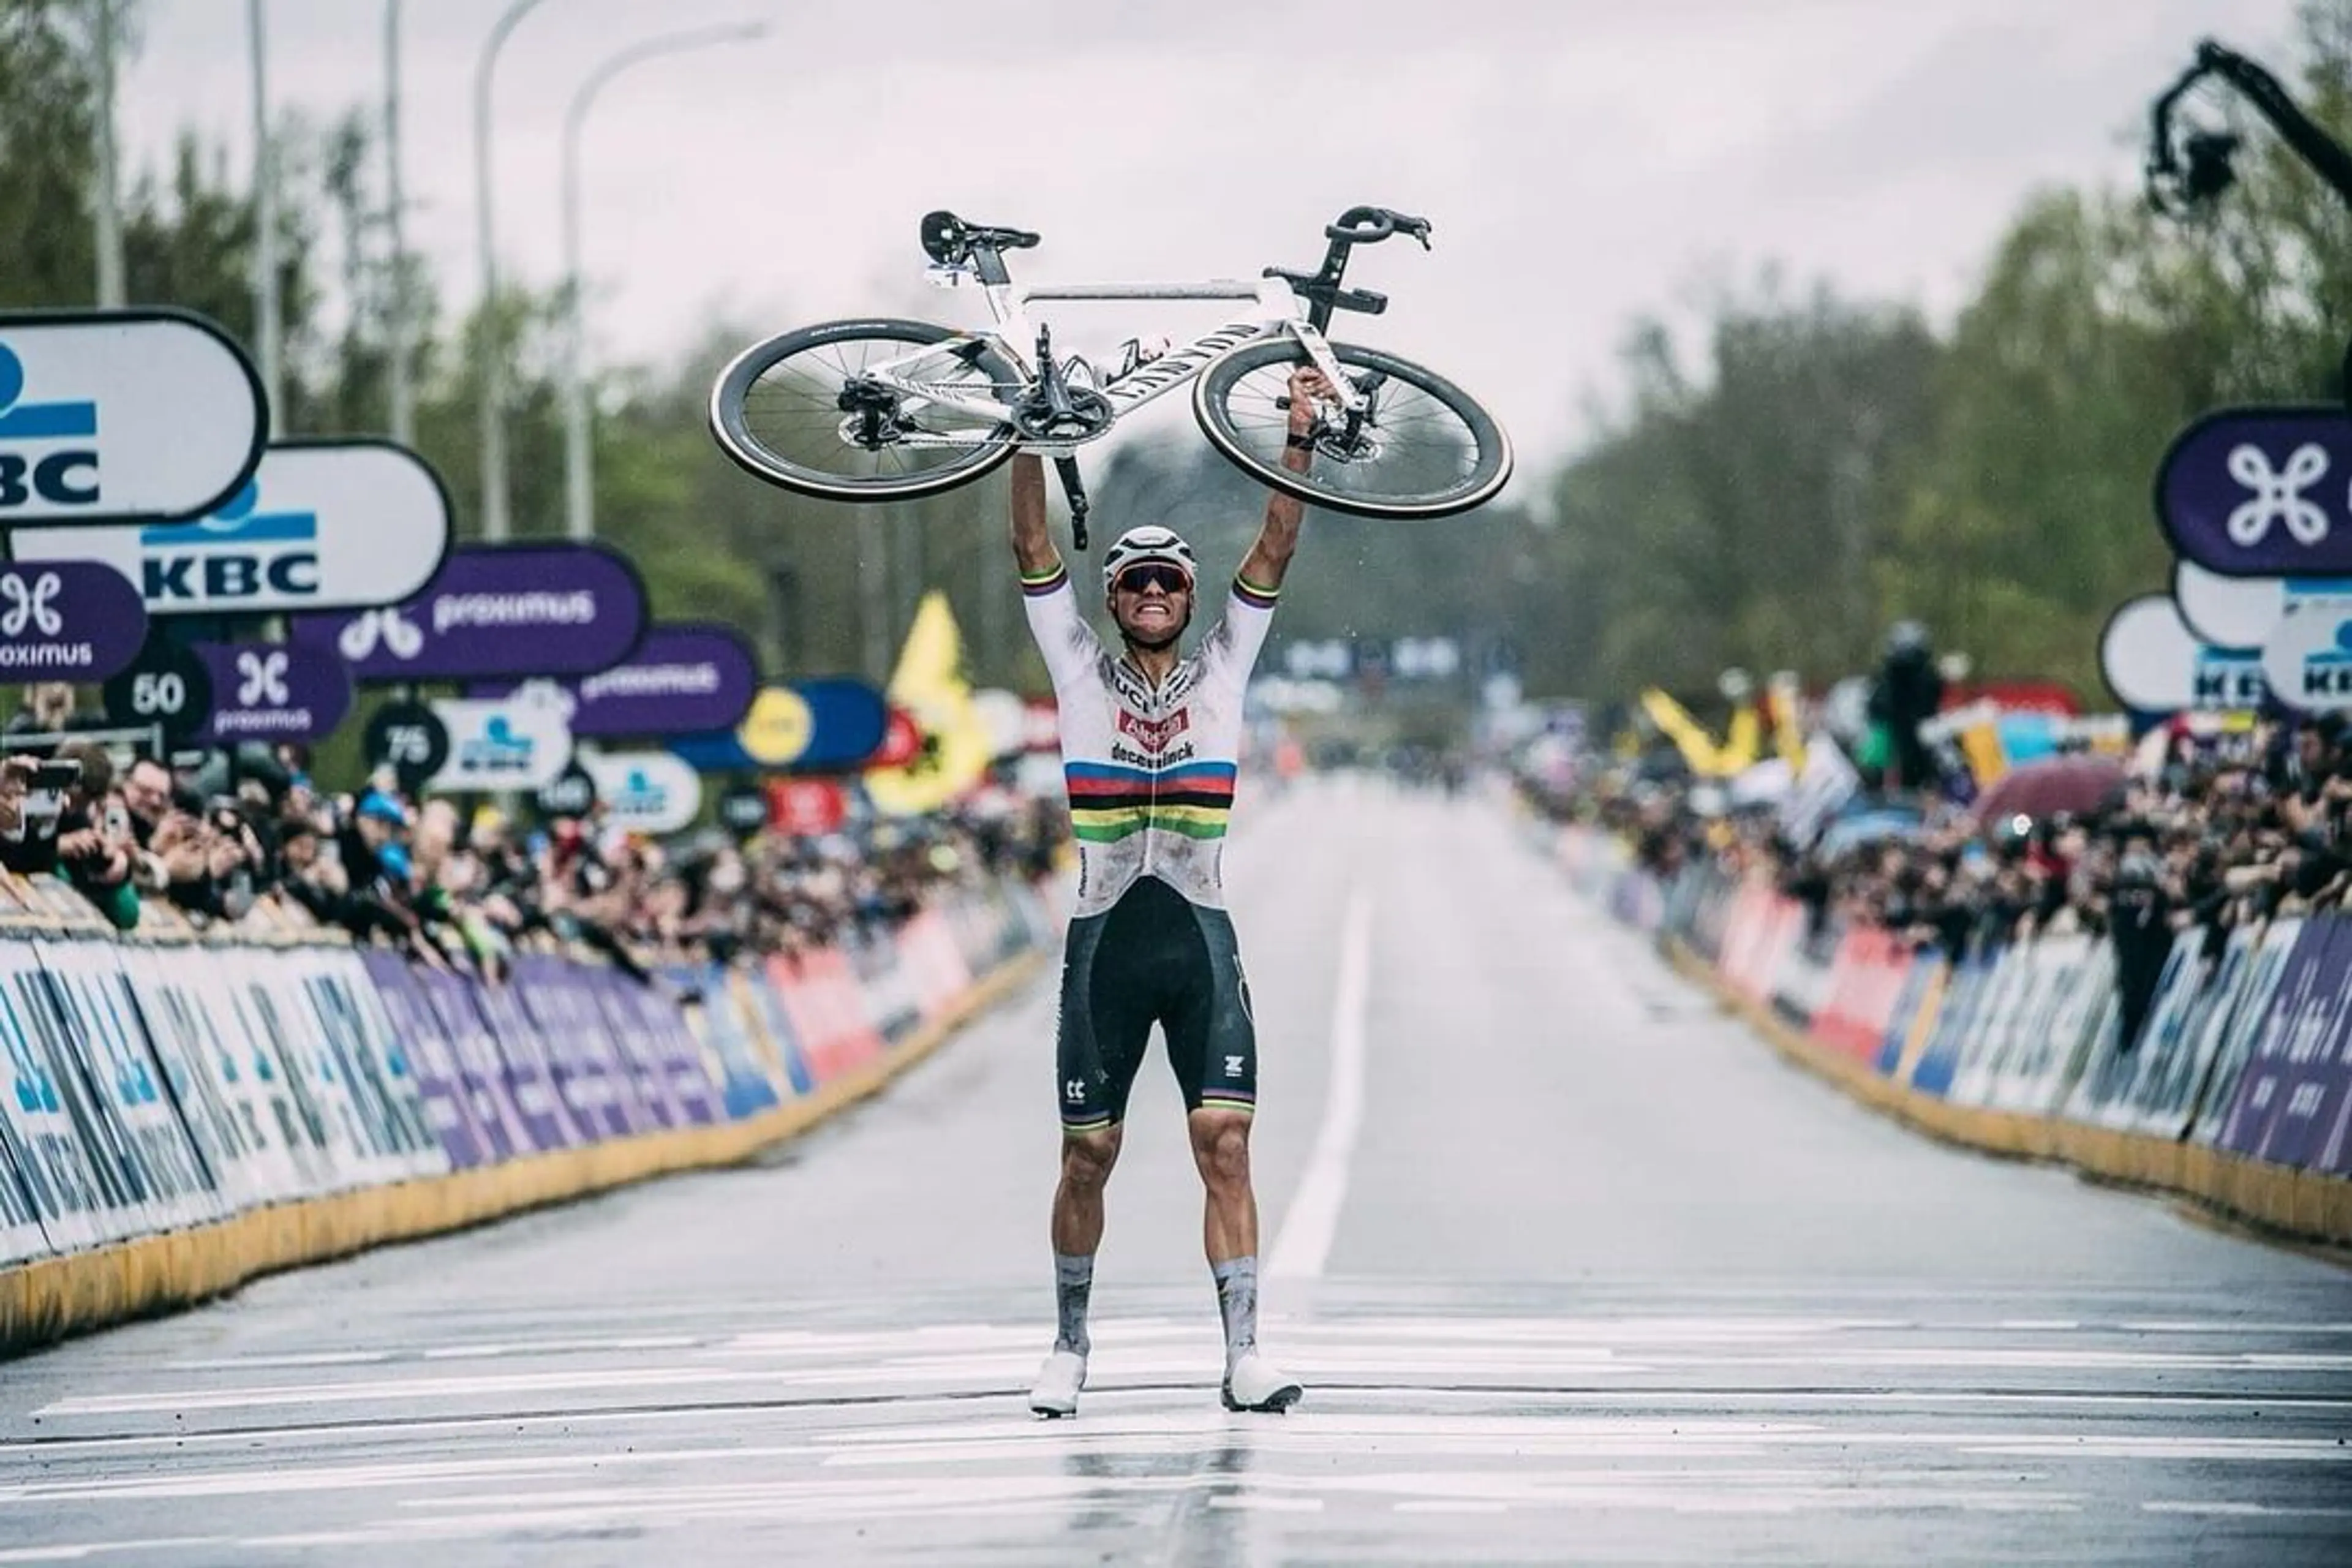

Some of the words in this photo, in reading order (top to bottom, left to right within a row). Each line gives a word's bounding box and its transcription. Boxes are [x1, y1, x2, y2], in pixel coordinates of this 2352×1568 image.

[141, 553, 319, 599] KBC
[132, 672, 185, 715] 50
[1114, 676, 1149, 714] UCI
[385, 725, 430, 764] 75
